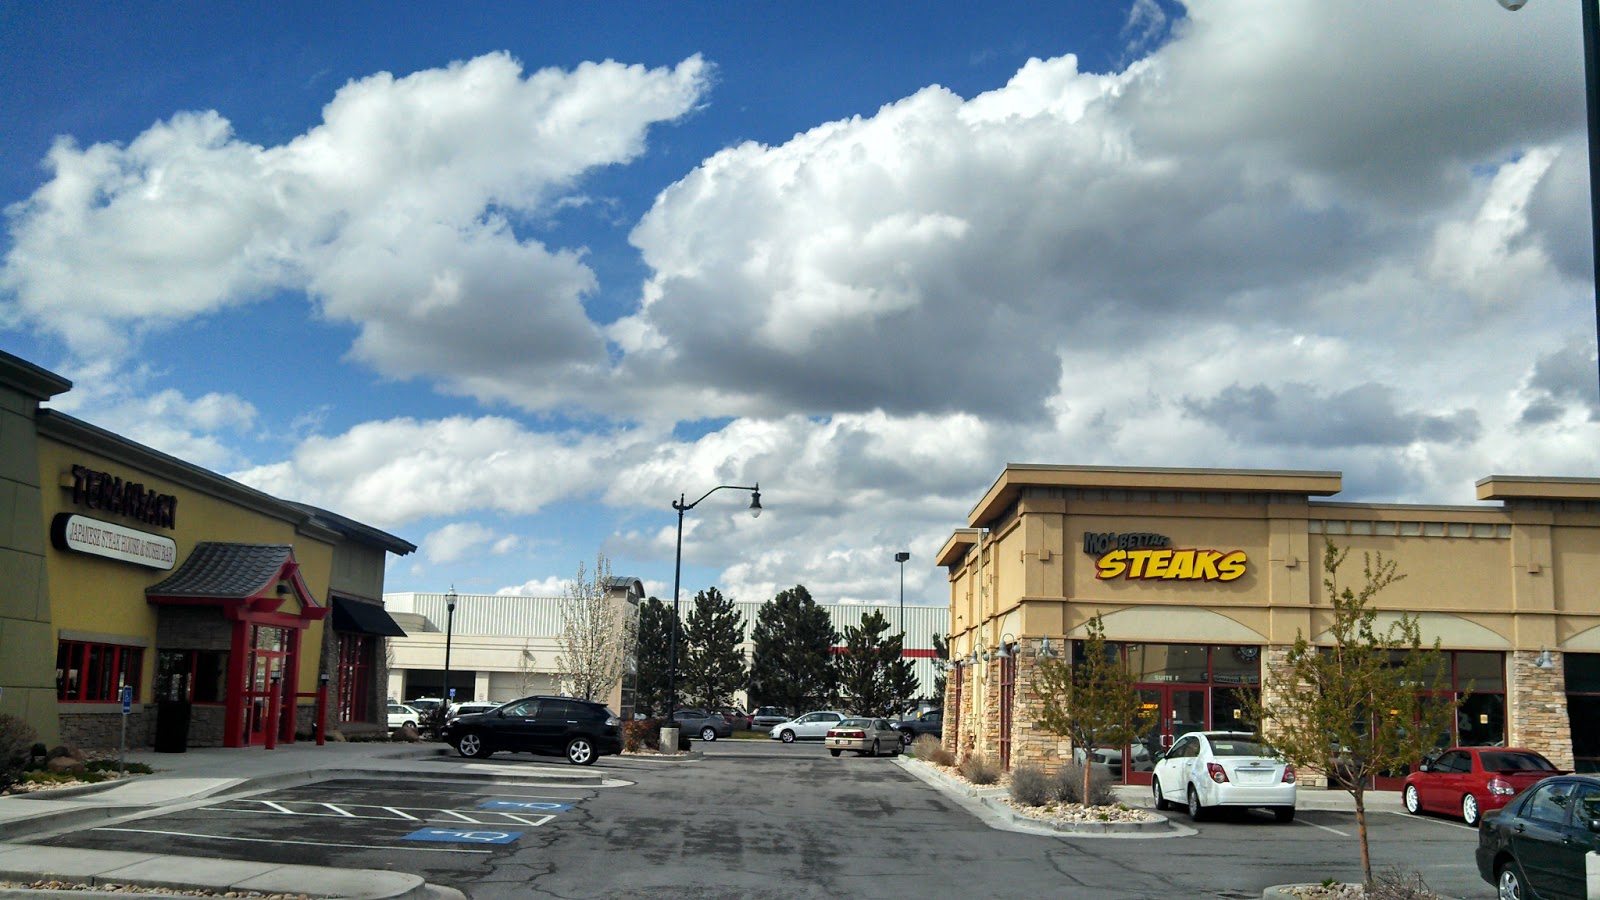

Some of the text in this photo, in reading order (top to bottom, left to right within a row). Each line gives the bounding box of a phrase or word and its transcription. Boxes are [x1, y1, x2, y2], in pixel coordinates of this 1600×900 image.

[69, 522, 101, 546] JAPANESE
[101, 530, 120, 551] STEAK
[121, 535, 140, 555] HOUSE
[145, 541, 162, 560] SUSHI
[161, 545, 173, 563] BAR
[1095, 549, 1248, 582] STEAKS
